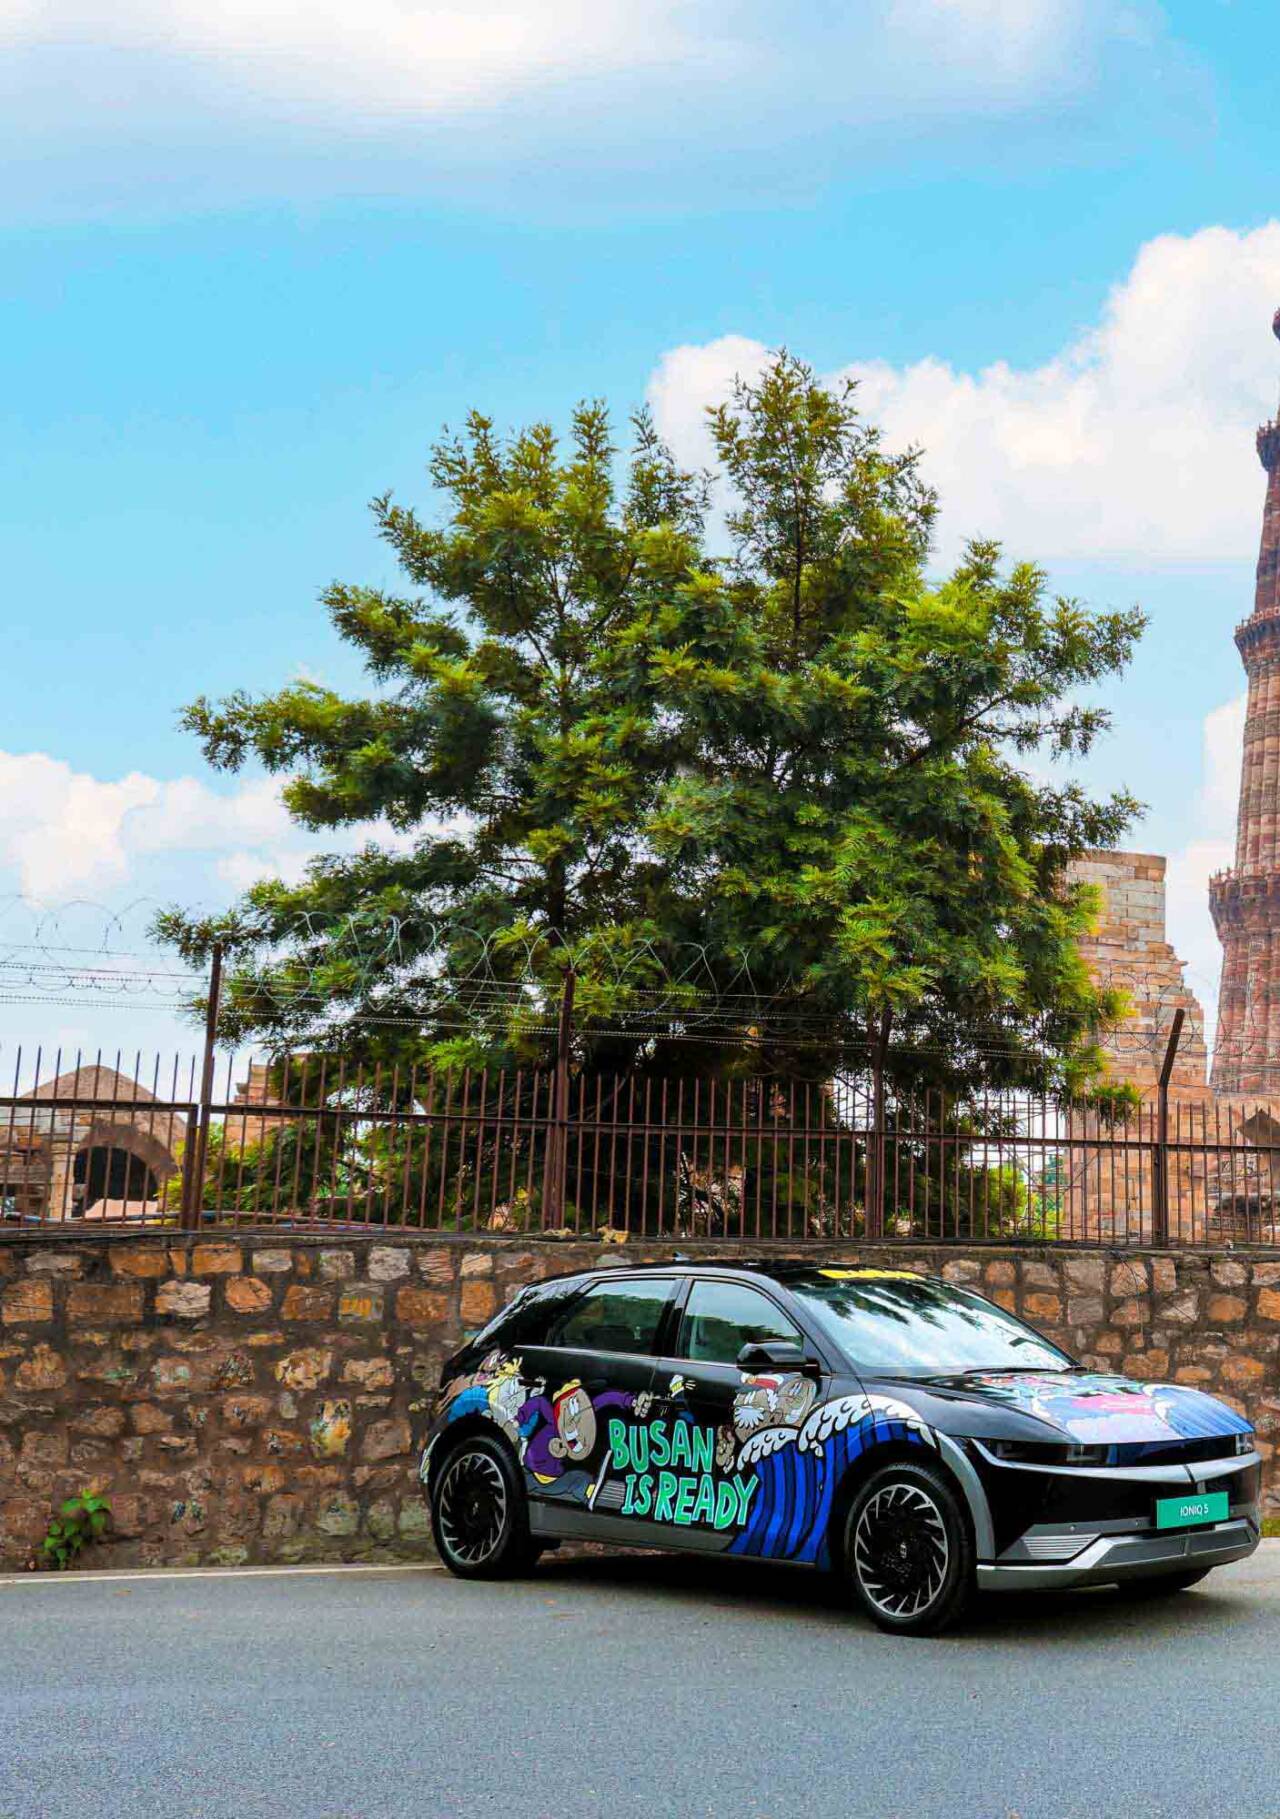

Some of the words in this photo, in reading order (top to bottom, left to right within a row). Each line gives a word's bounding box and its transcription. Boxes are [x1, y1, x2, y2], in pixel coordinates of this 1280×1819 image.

[608, 1418, 714, 1474] BUSAN
[621, 1473, 654, 1515] IS
[654, 1471, 759, 1530] READY
[1180, 1504, 1203, 1517] IONIQ
[1203, 1503, 1209, 1514] 5
